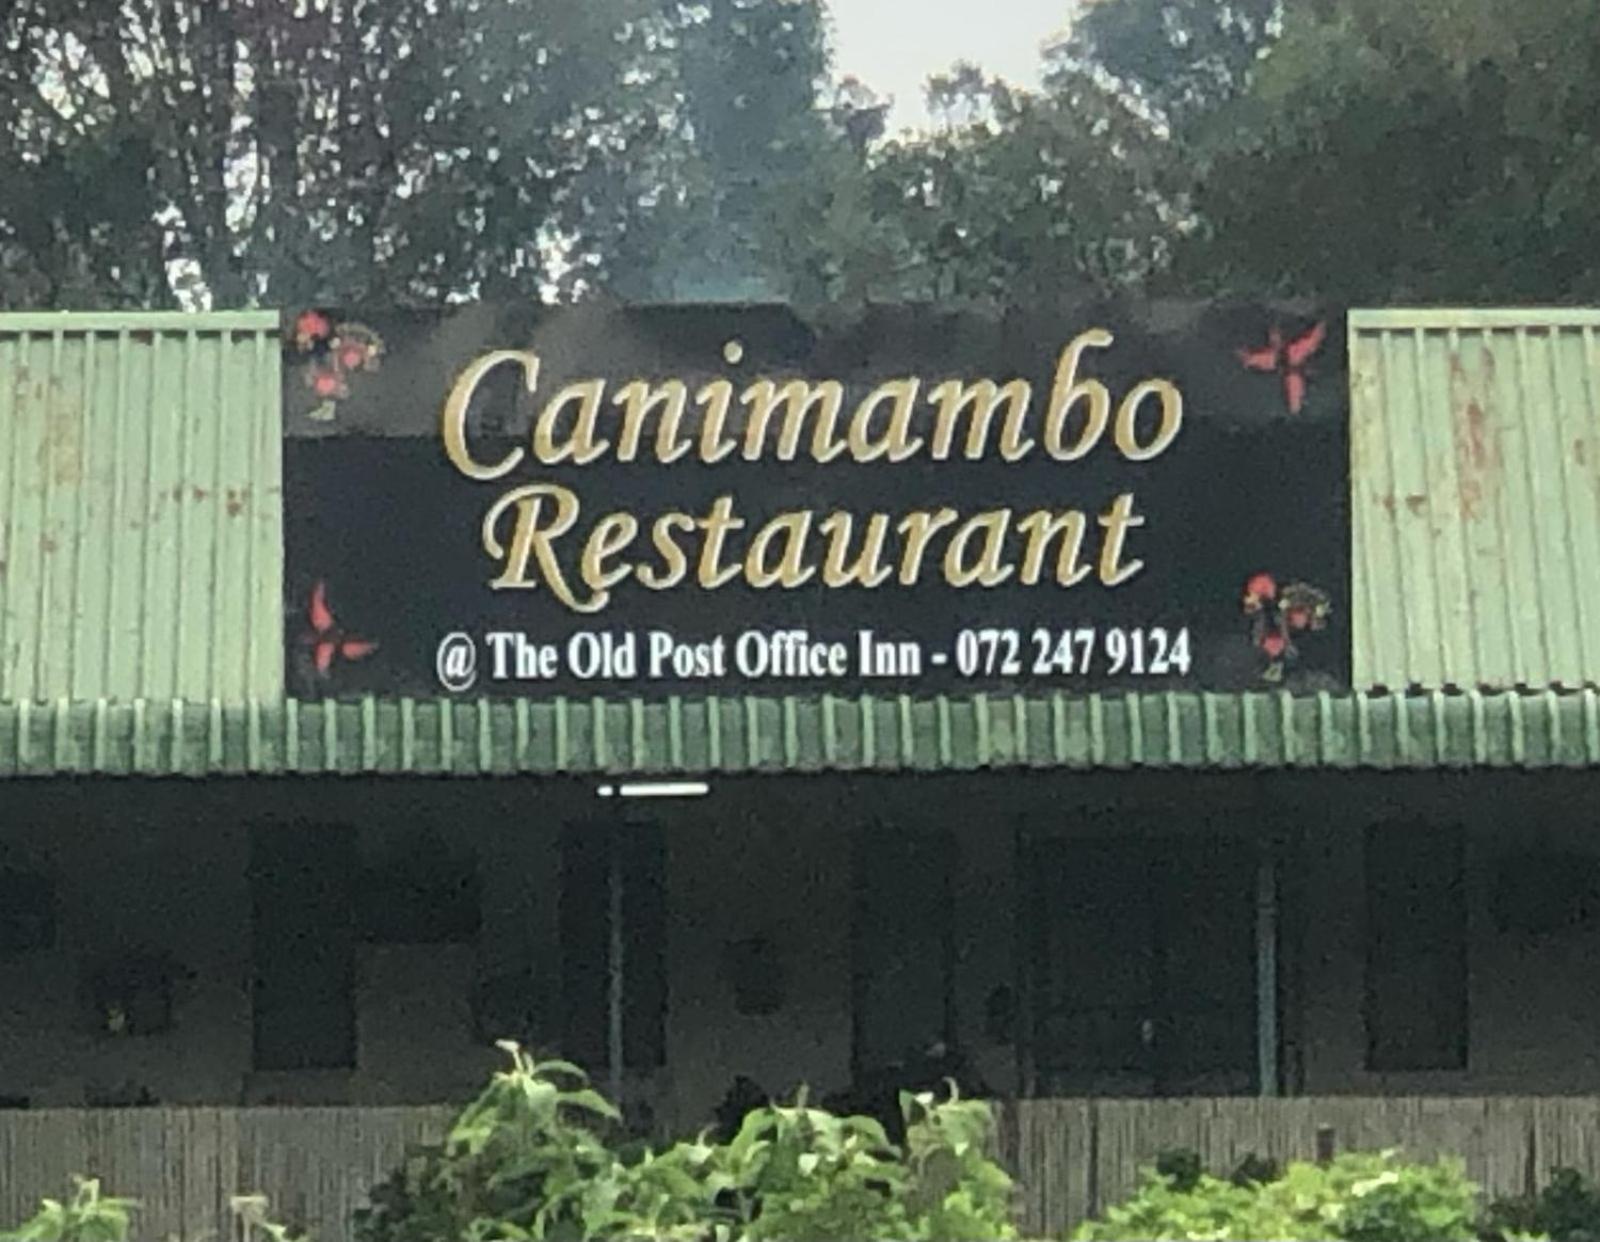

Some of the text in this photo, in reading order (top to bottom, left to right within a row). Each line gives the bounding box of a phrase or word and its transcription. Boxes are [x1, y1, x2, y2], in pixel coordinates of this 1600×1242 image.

[442, 329, 1184, 480] Canimambo
[482, 484, 1146, 613] Restaurant
[437, 632, 476, 692] @
[486, 630, 558, 679] The
[567, 630, 637, 679] Old
[648, 630, 726, 679] Post
[736, 629, 847, 679] Office
[858, 629, 921, 678] Inn
[957, 628, 1020, 677] 072
[1032, 627, 1099, 676] 247
[1106, 627, 1192, 676] 9124
